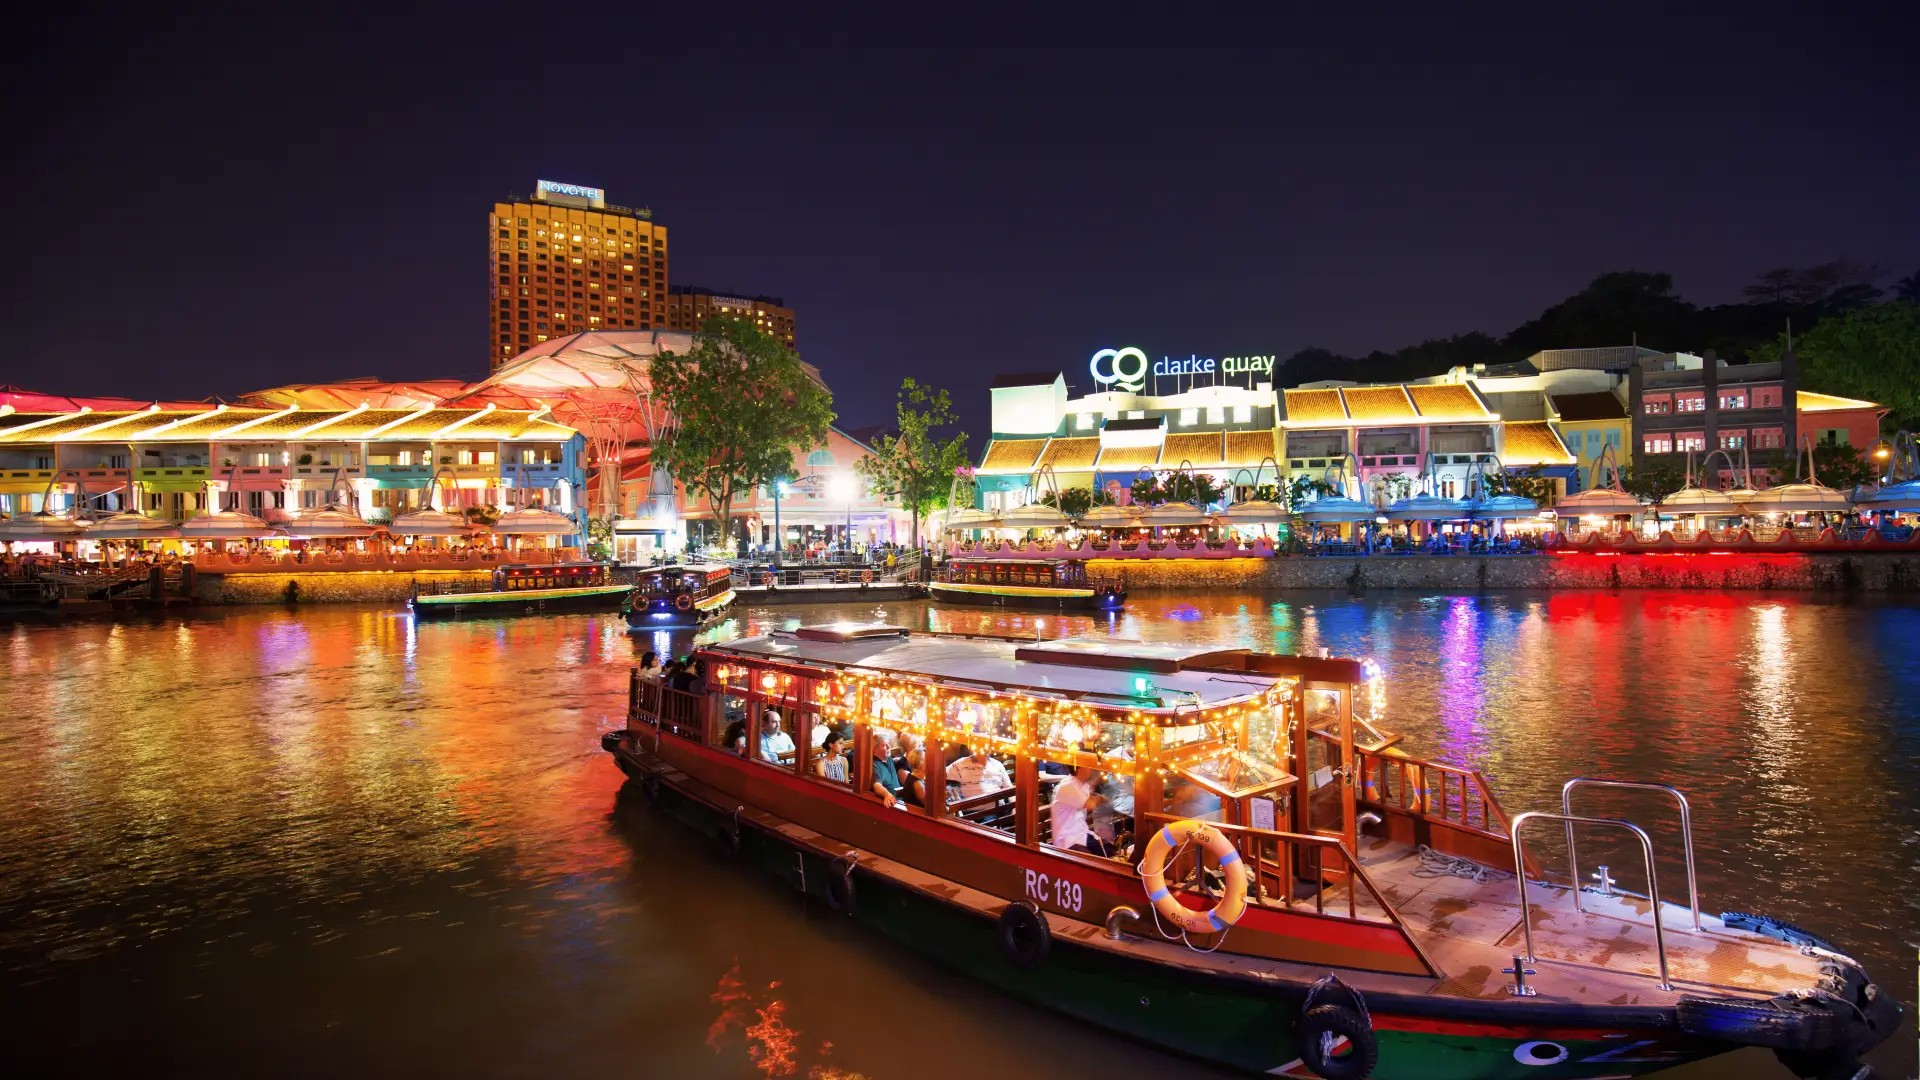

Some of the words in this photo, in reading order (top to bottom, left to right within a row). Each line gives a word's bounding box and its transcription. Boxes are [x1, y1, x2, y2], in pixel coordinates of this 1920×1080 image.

[540, 180, 600, 199] NOVOTEL
[1090, 347, 1148, 392] CQ
[1153, 354, 1215, 376] clarke
[1222, 355, 1276, 377] quay
[1025, 868, 1049, 902] RC
[1054, 878, 1083, 913] 139
